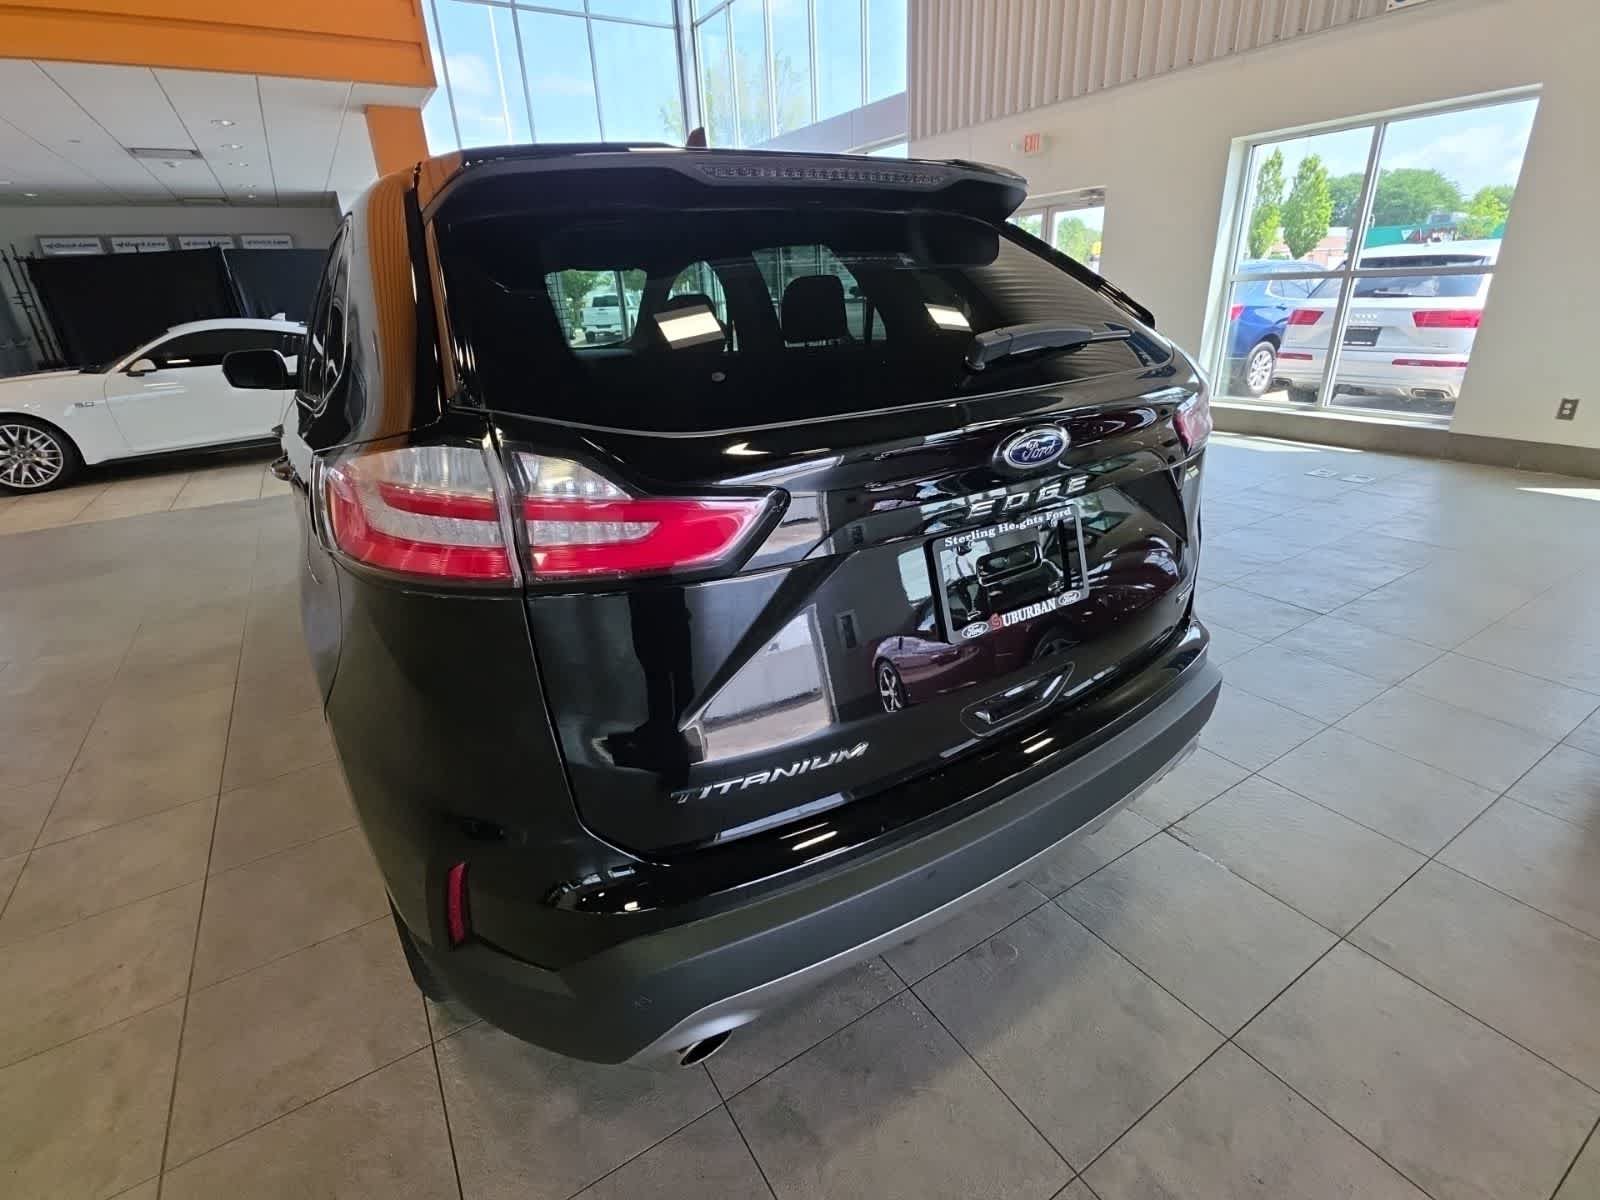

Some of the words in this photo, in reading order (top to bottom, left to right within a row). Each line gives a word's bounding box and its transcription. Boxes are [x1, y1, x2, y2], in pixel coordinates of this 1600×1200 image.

[966, 475, 1089, 519] EDGE
[944, 526, 996, 547] Sterling
[1046, 507, 1072, 521] Ford
[989, 598, 1057, 630] SUBURBAN
[670, 742, 869, 804] TITANIUM
